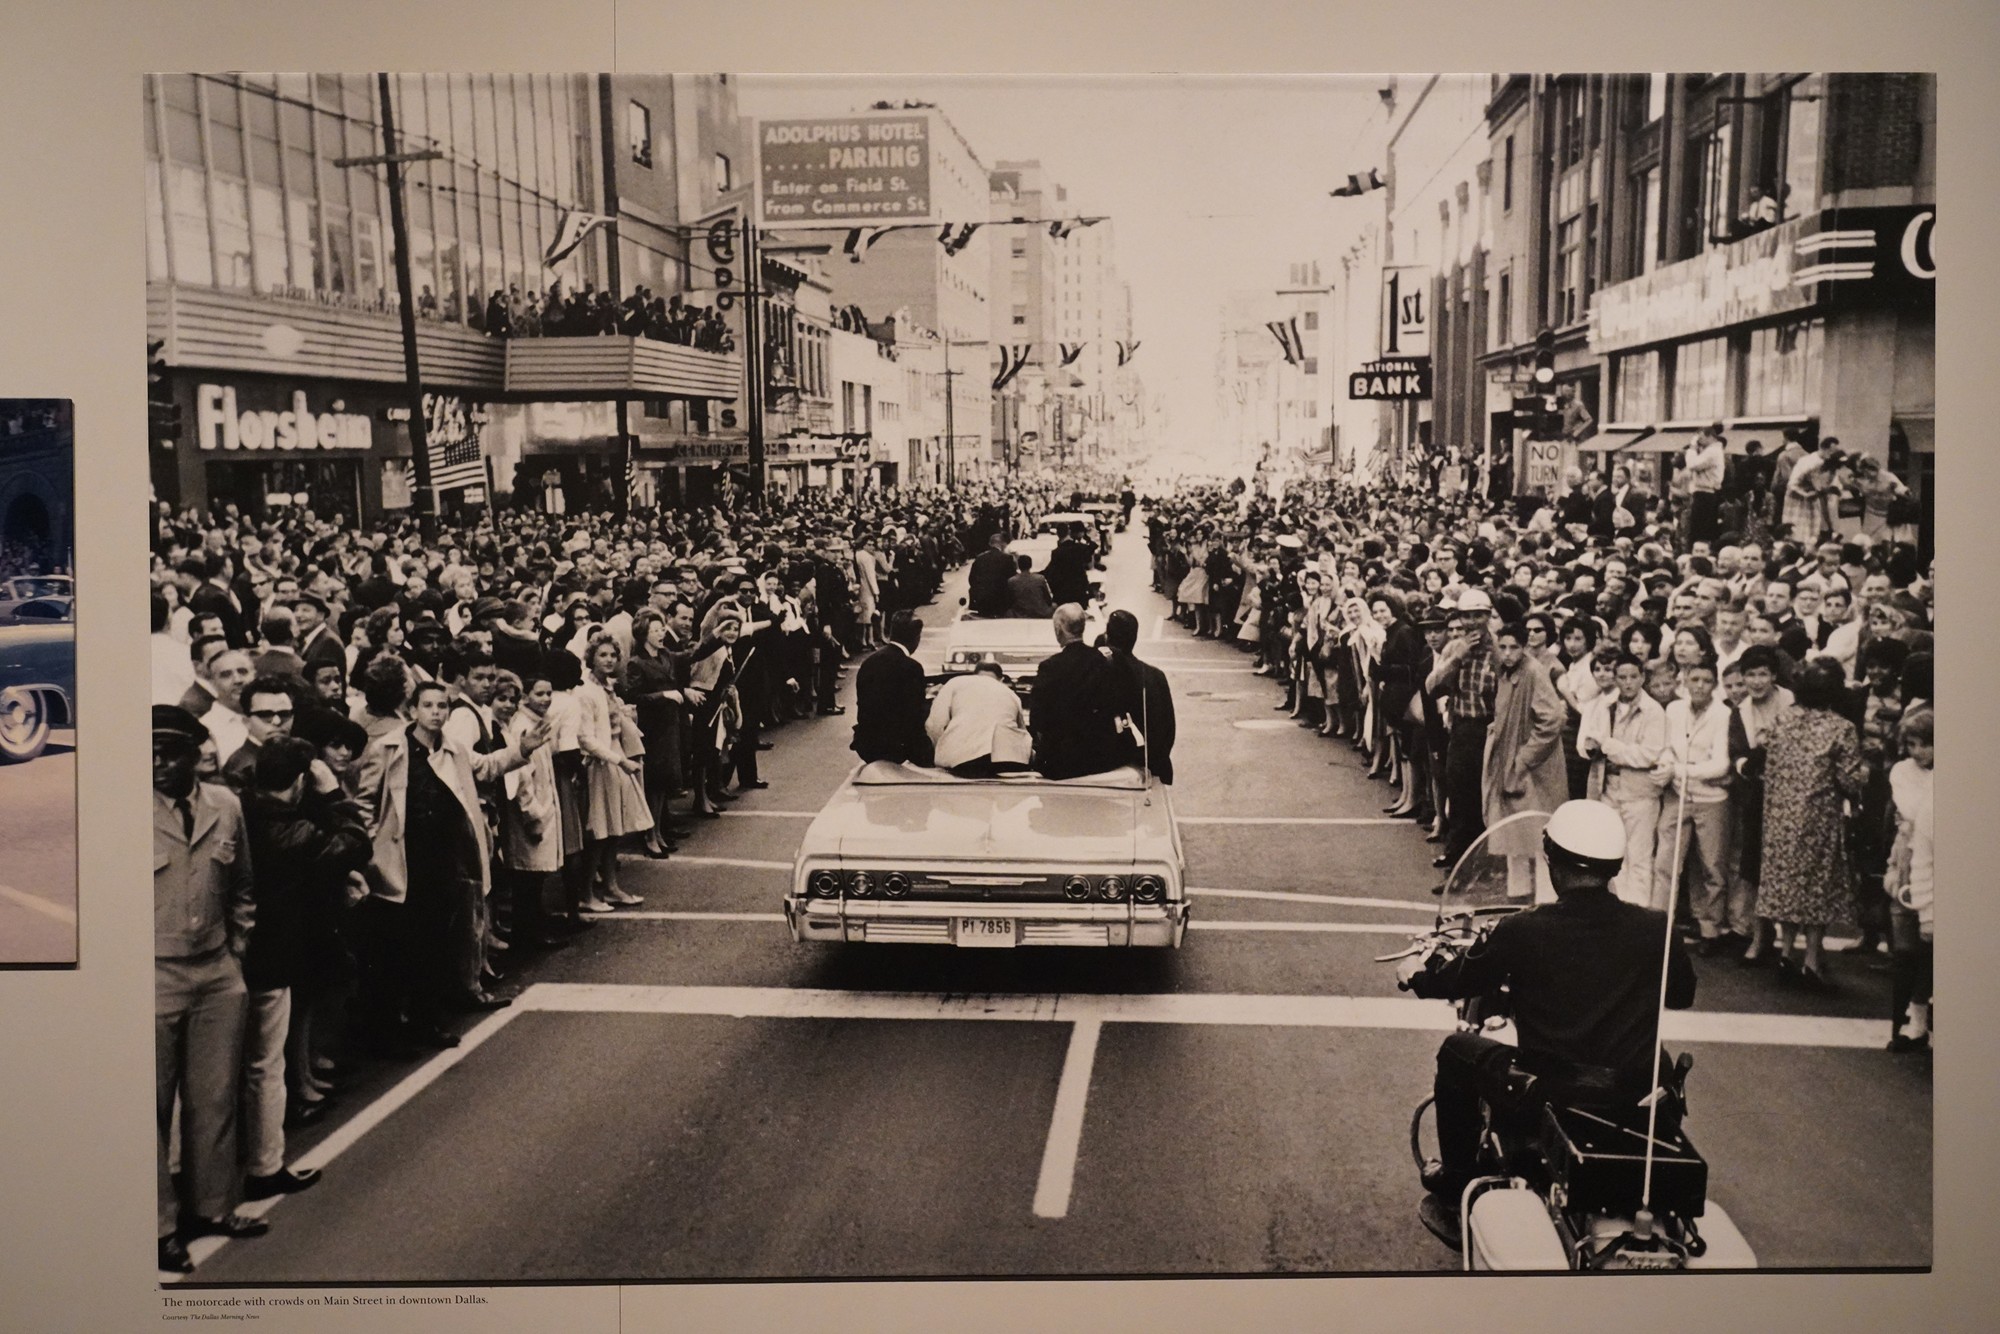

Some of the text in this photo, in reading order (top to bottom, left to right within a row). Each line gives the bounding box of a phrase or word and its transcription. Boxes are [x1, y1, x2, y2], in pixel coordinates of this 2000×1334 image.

[765, 122, 925, 145] ADOLPHUS HOTEL
[829, 145, 921, 169] PARKING
[772, 180, 812, 196] Enter
[819, 183, 838, 194] on
[846, 177, 883, 193] Field
[765, 200, 805, 215] From
[812, 199, 902, 214] Commerce
[1385, 271, 1425, 353] 1st
[1353, 375, 1421, 396] BANK
[198, 384, 372, 450] Florsheim
[1531, 445, 1559, 461] NO
[1530, 465, 1558, 482] TURN
[980, 920, 1011, 934] 7856
[162, 1294, 489, 1307] The motorcade with crowds on Main Street in downtown Dallas.
